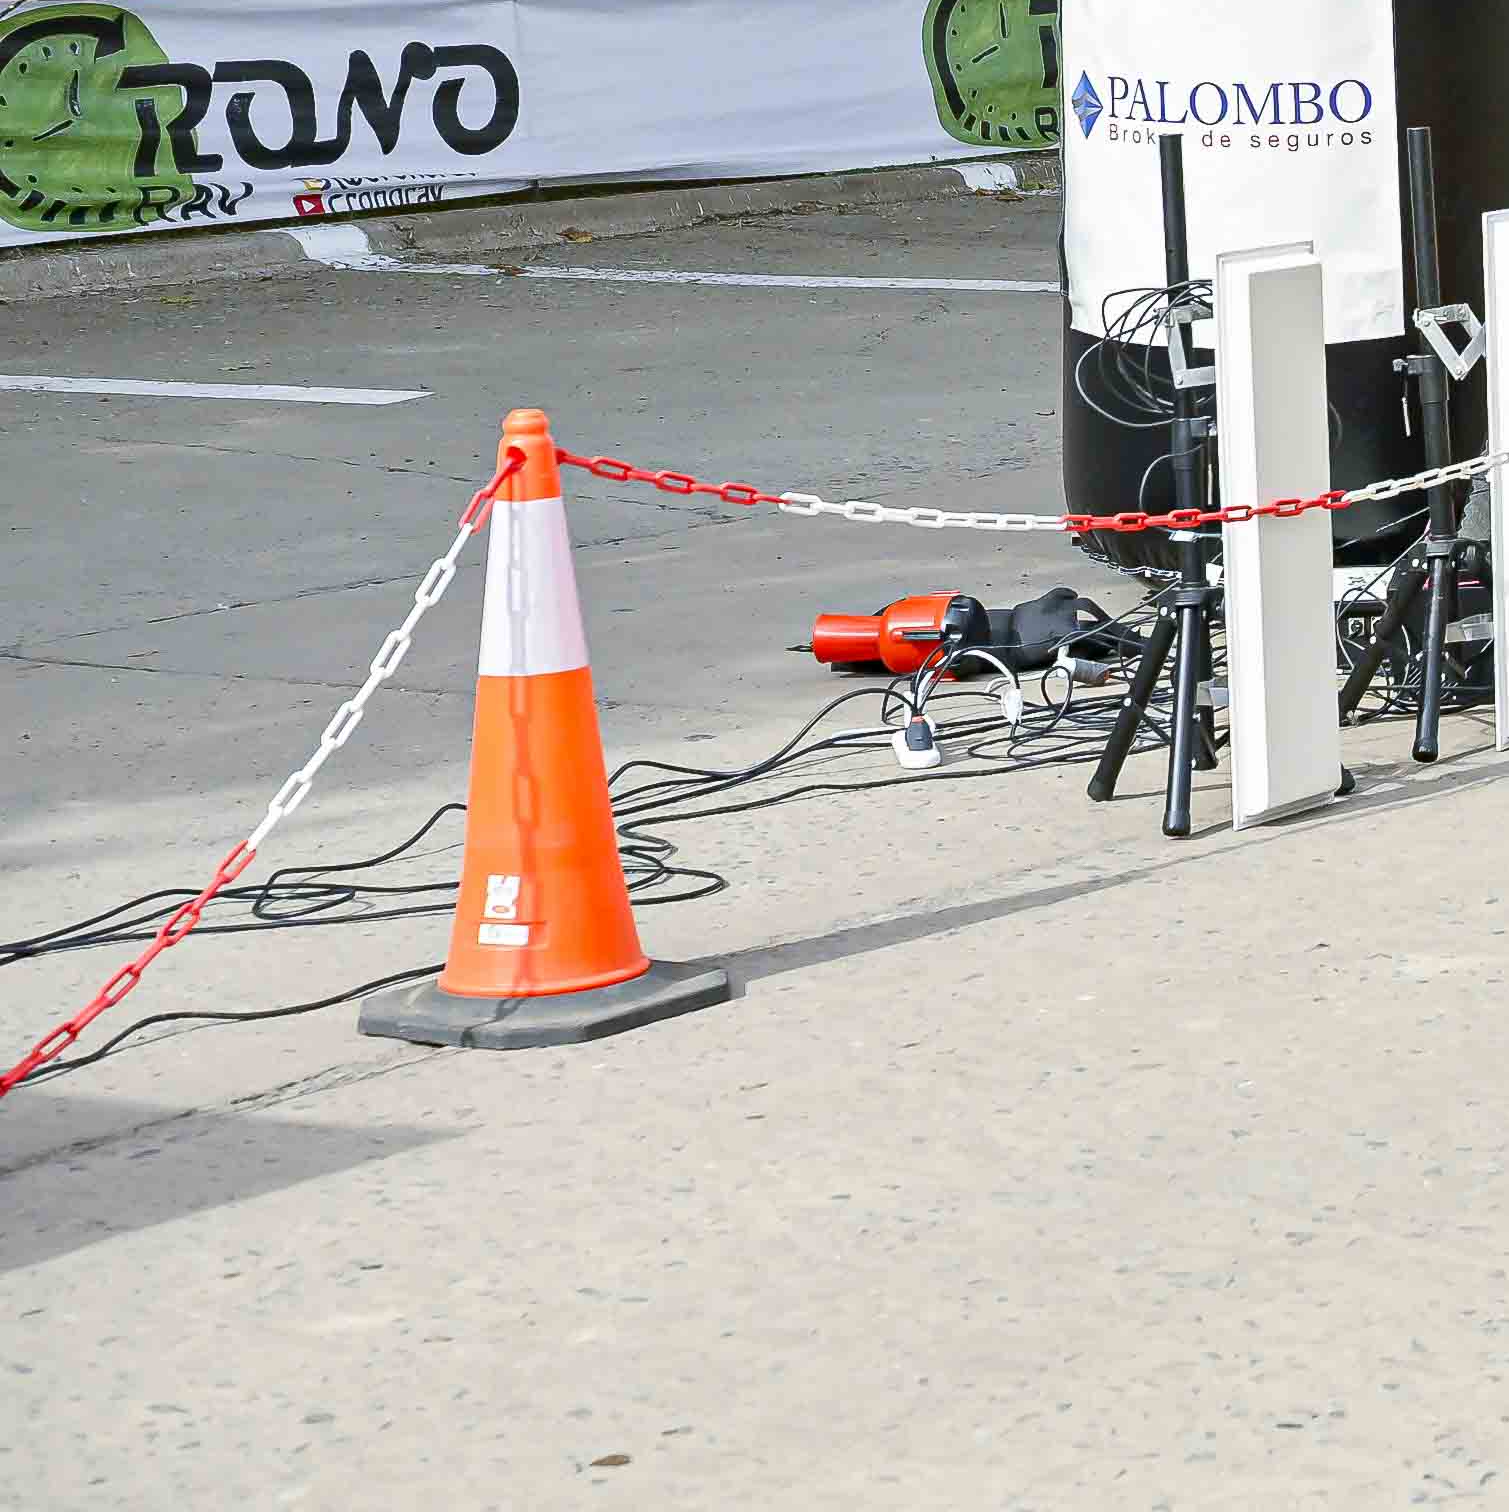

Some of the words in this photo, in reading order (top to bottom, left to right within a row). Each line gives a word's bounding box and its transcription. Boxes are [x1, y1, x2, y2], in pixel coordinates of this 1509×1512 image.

[1107, 76, 1372, 125] PALOMBO
[1109, 124, 1158, 145] Brok
[1201, 130, 1231, 148] de
[1250, 129, 1372, 152] seguros
[133, 181, 254, 226] RAV
